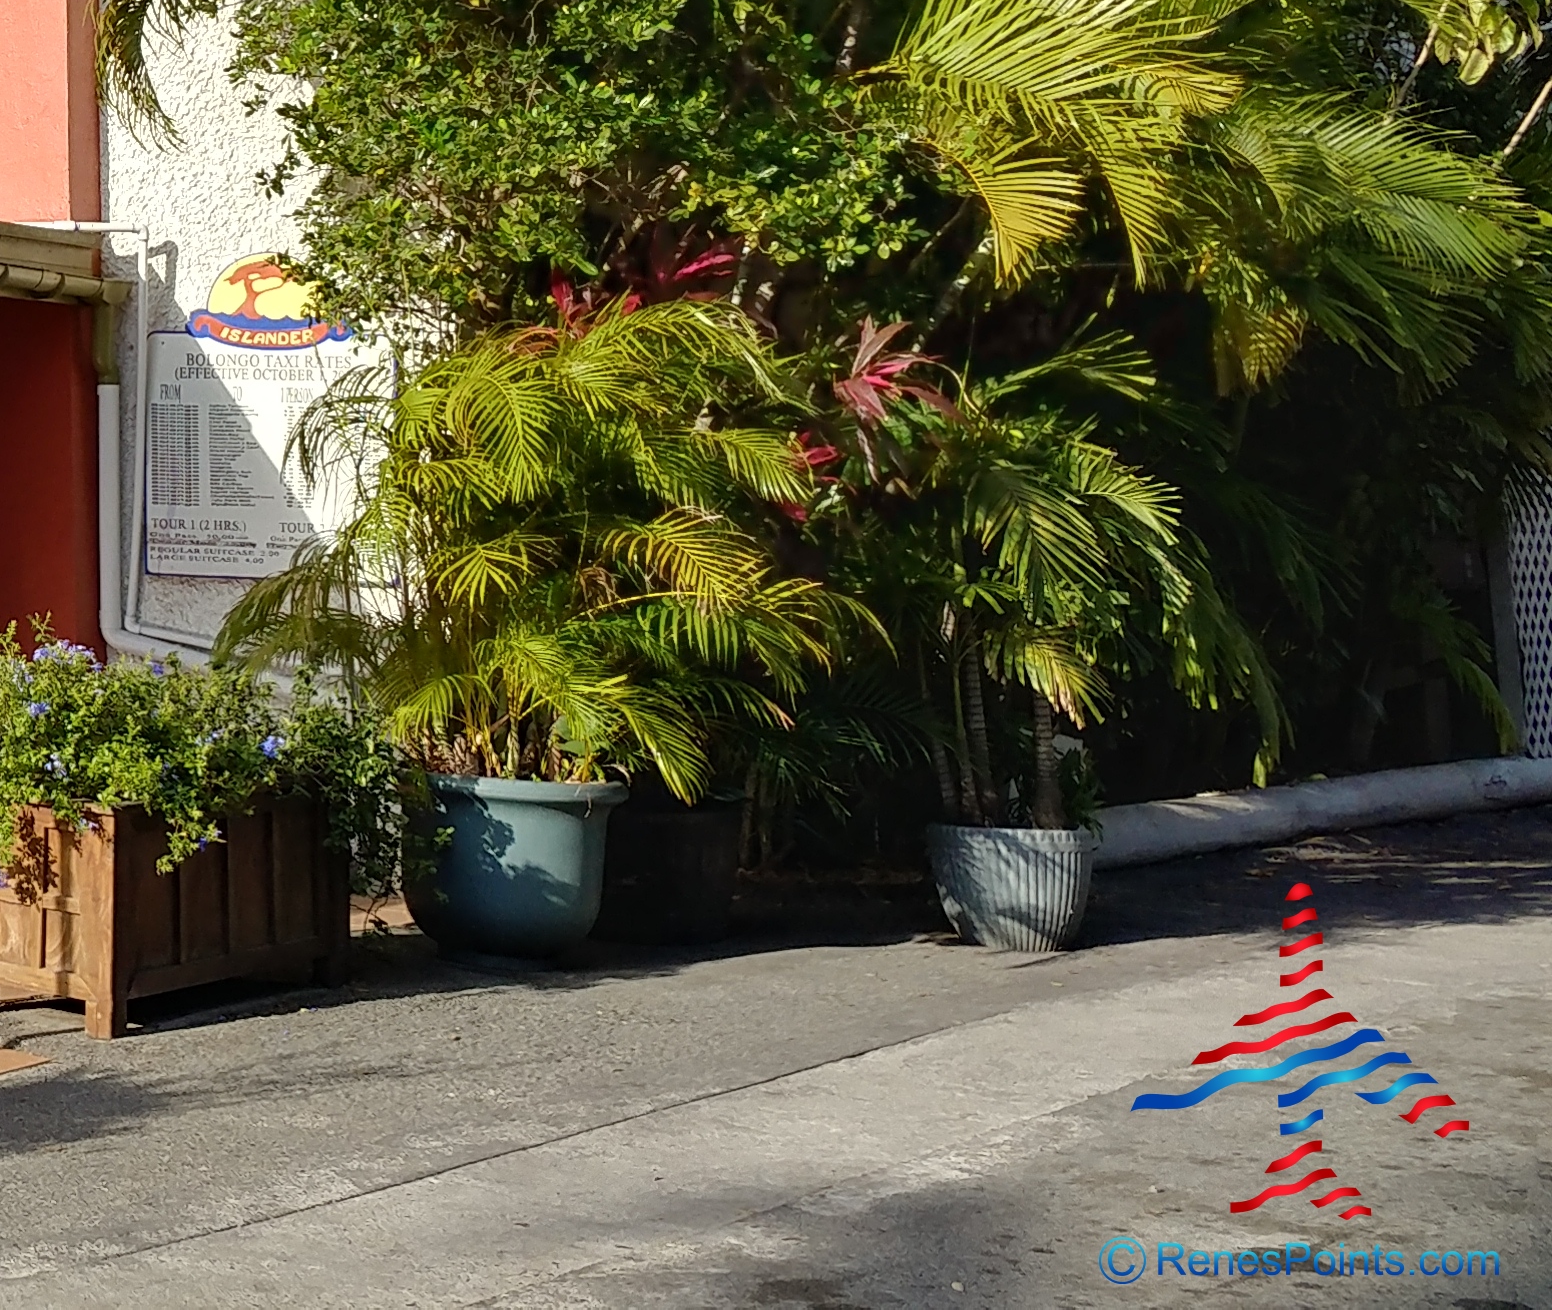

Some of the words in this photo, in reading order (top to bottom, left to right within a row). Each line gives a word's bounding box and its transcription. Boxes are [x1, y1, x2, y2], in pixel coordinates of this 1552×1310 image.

[219, 326, 314, 346] ISLANDER
[186, 352, 260, 368] BOLONGO
[263, 354, 300, 368] TAXI
[304, 355, 352, 369] RATES
[174, 366, 249, 381] (EFFECTIVE
[252, 368, 315, 381] OCTOBER
[160, 383, 181, 403] FROM
[232, 385, 243, 402] TO
[151, 518, 187, 530] TOUR
[278, 522, 316, 533] TOUR
[203, 548, 255, 556] SUITCASE
